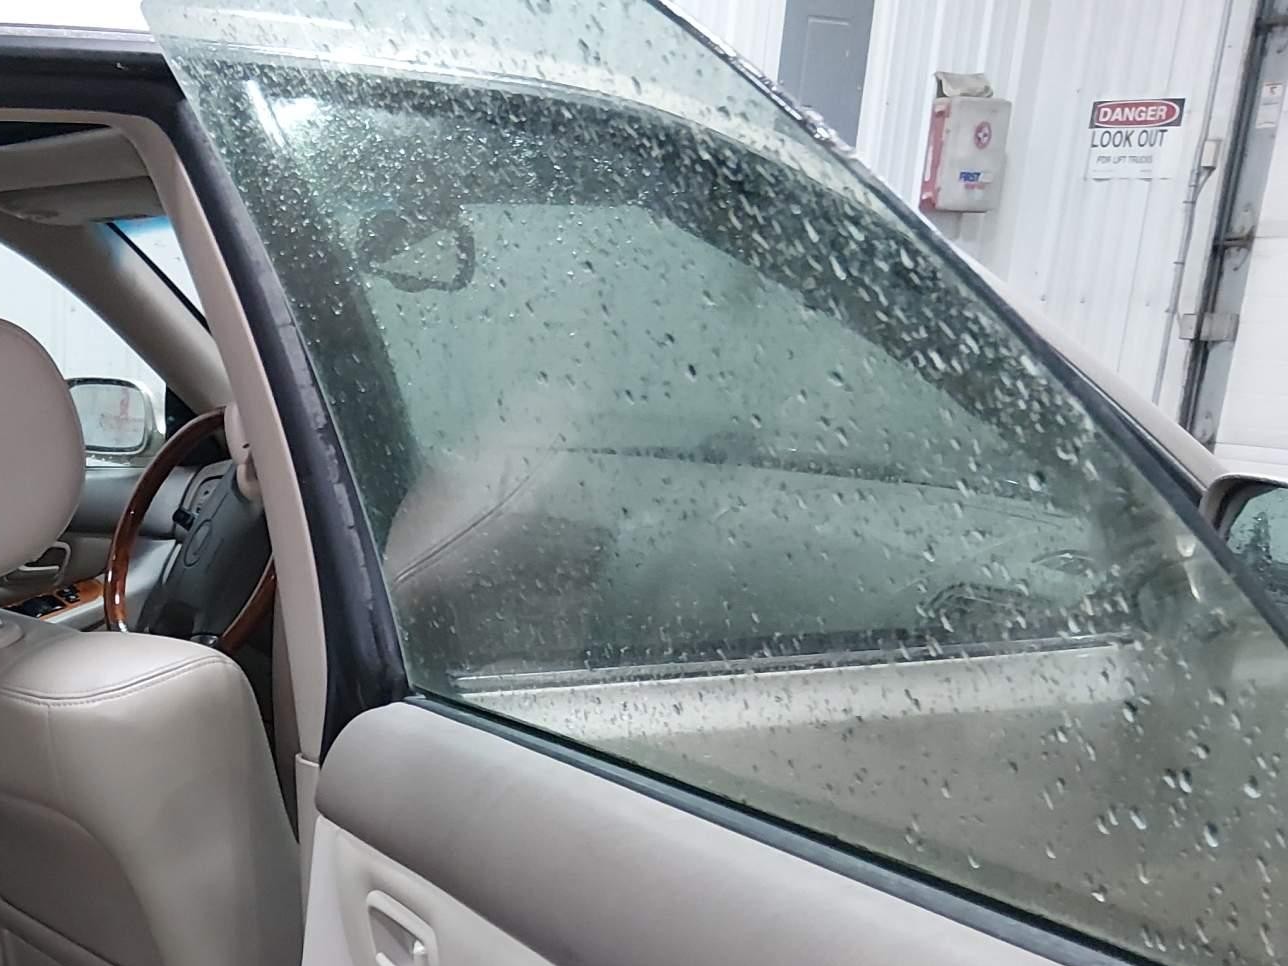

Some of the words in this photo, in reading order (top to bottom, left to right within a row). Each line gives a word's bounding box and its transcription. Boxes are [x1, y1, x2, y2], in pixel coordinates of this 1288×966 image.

[1098, 105, 1168, 122] DANGER
[1090, 130, 1135, 148] LOOK
[1137, 129, 1169, 148] OUT
